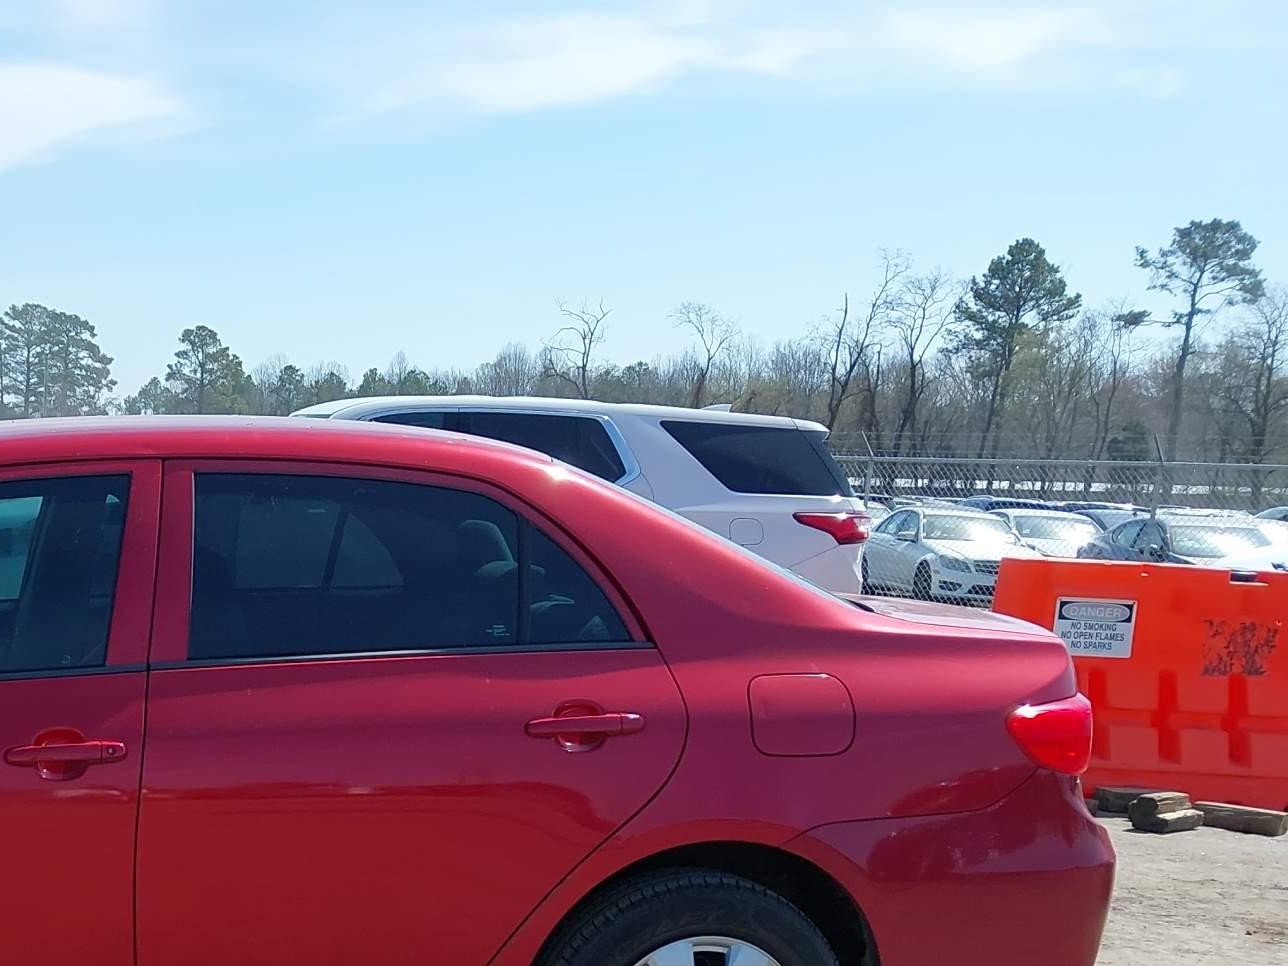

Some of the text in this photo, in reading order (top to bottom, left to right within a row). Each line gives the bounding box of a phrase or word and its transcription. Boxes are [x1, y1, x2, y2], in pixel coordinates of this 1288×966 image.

[1069, 607, 1122, 618] DANGER
[1070, 622, 1117, 632] NO SMOKING
[1060, 631, 1125, 642] NO OPEN FLAMES
[1070, 640, 1113, 651] NO SPARKS
